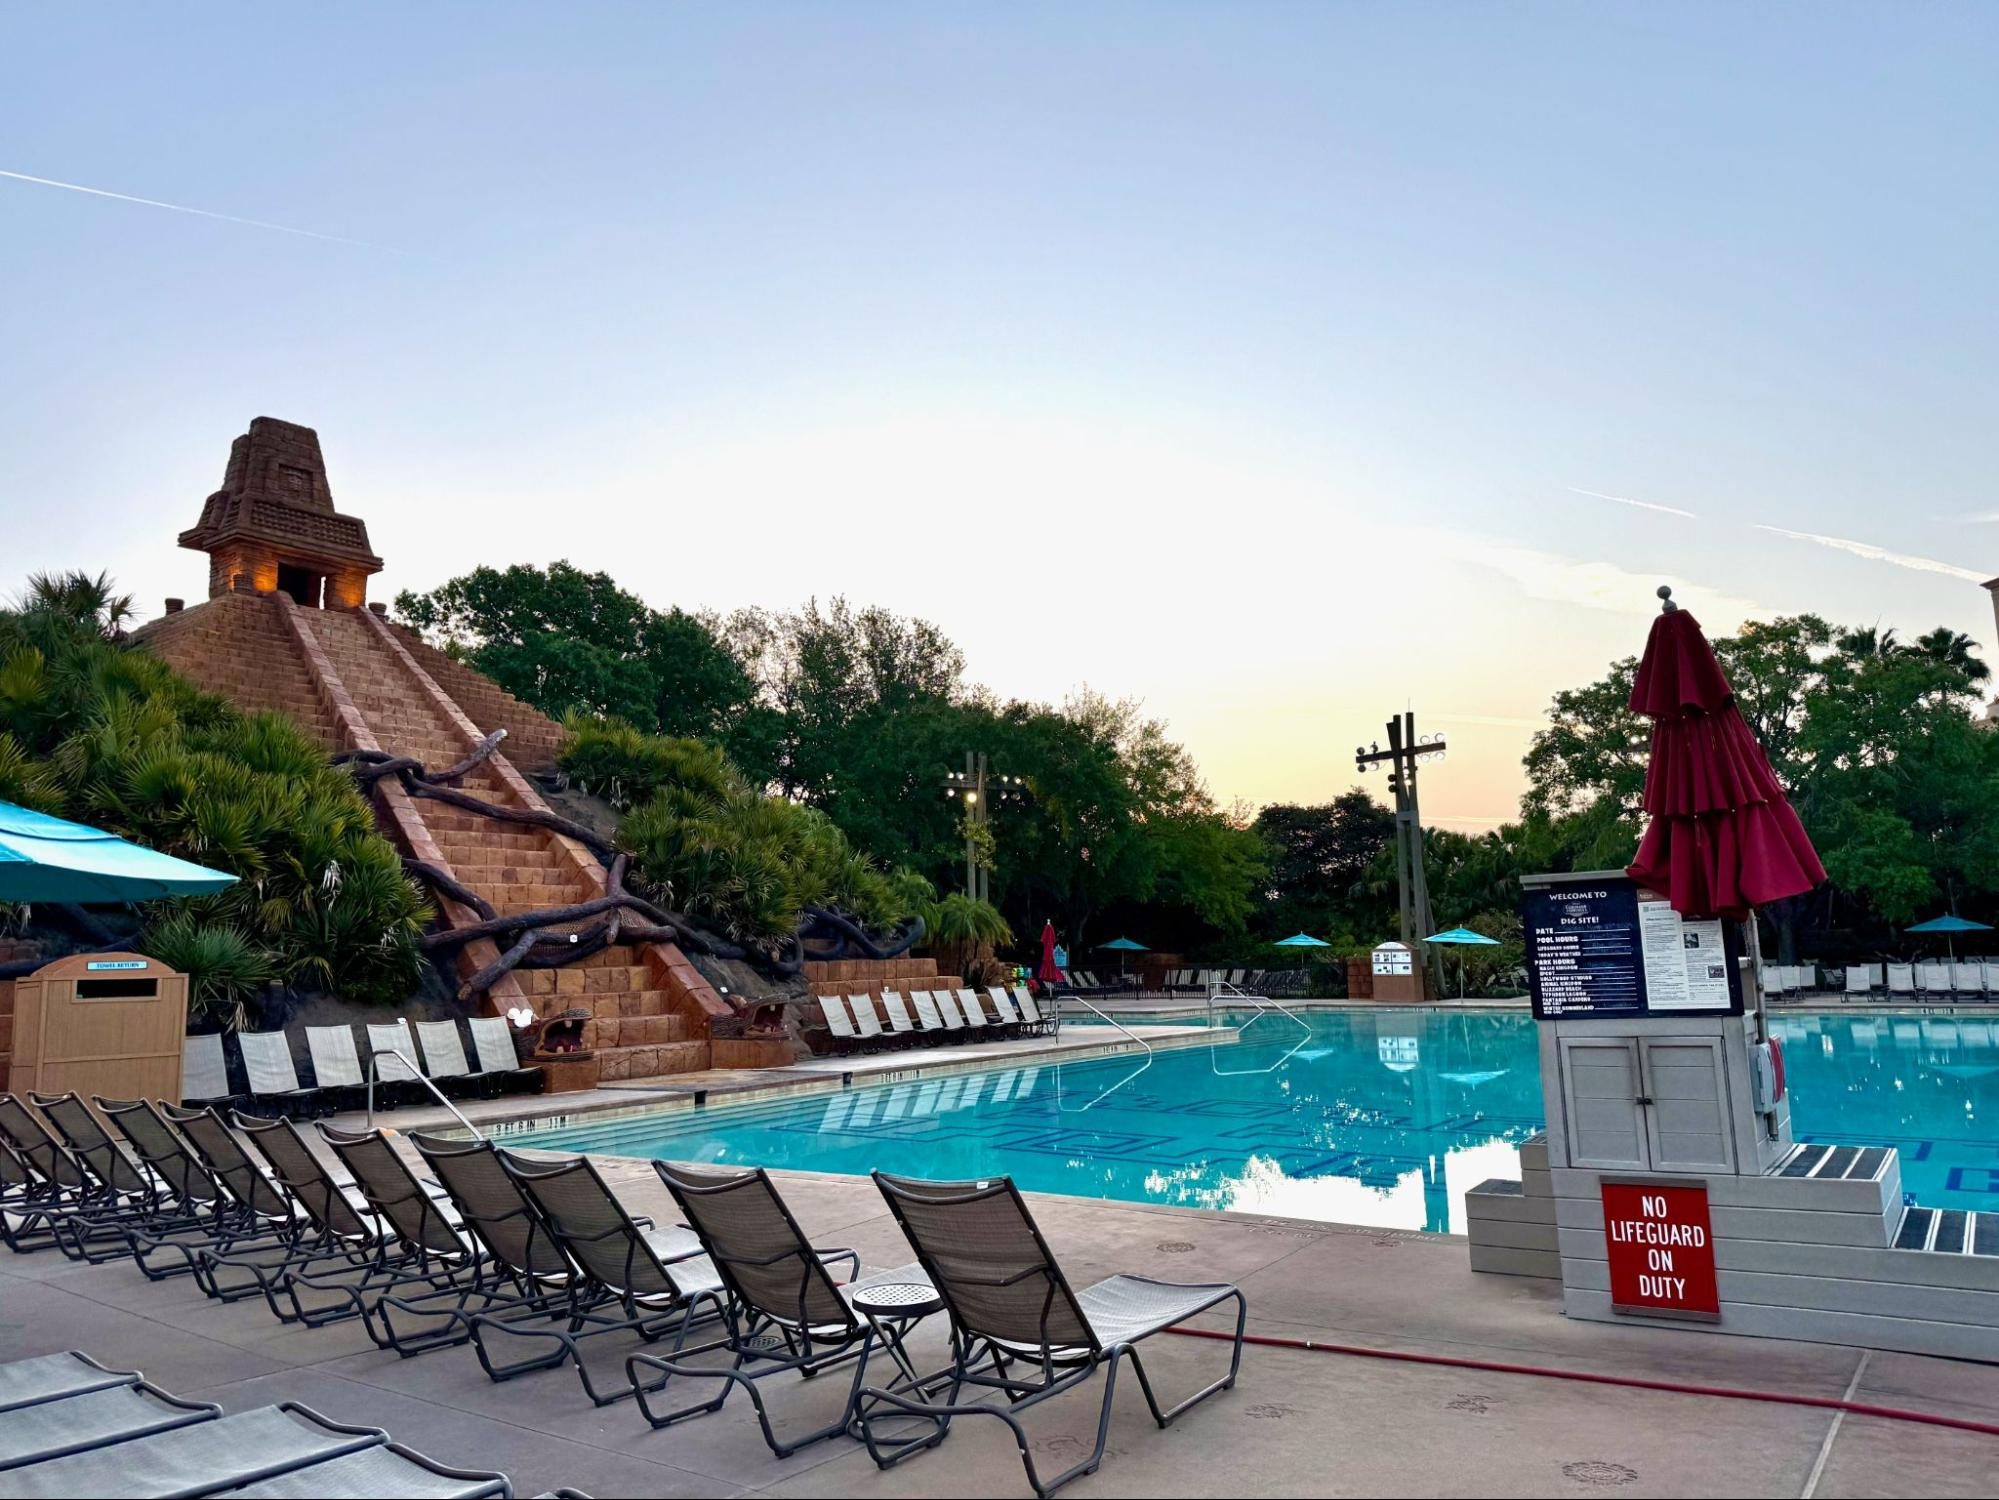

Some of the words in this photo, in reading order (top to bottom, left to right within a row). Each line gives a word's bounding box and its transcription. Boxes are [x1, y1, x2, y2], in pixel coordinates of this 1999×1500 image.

[1549, 892, 1592, 900] WELCOME
[1642, 1196, 1667, 1218] NO
[1610, 1220, 1705, 1247] LIFEGUARD
[1648, 1249, 1673, 1272] ON
[1639, 1274, 1686, 1300] DUTY
